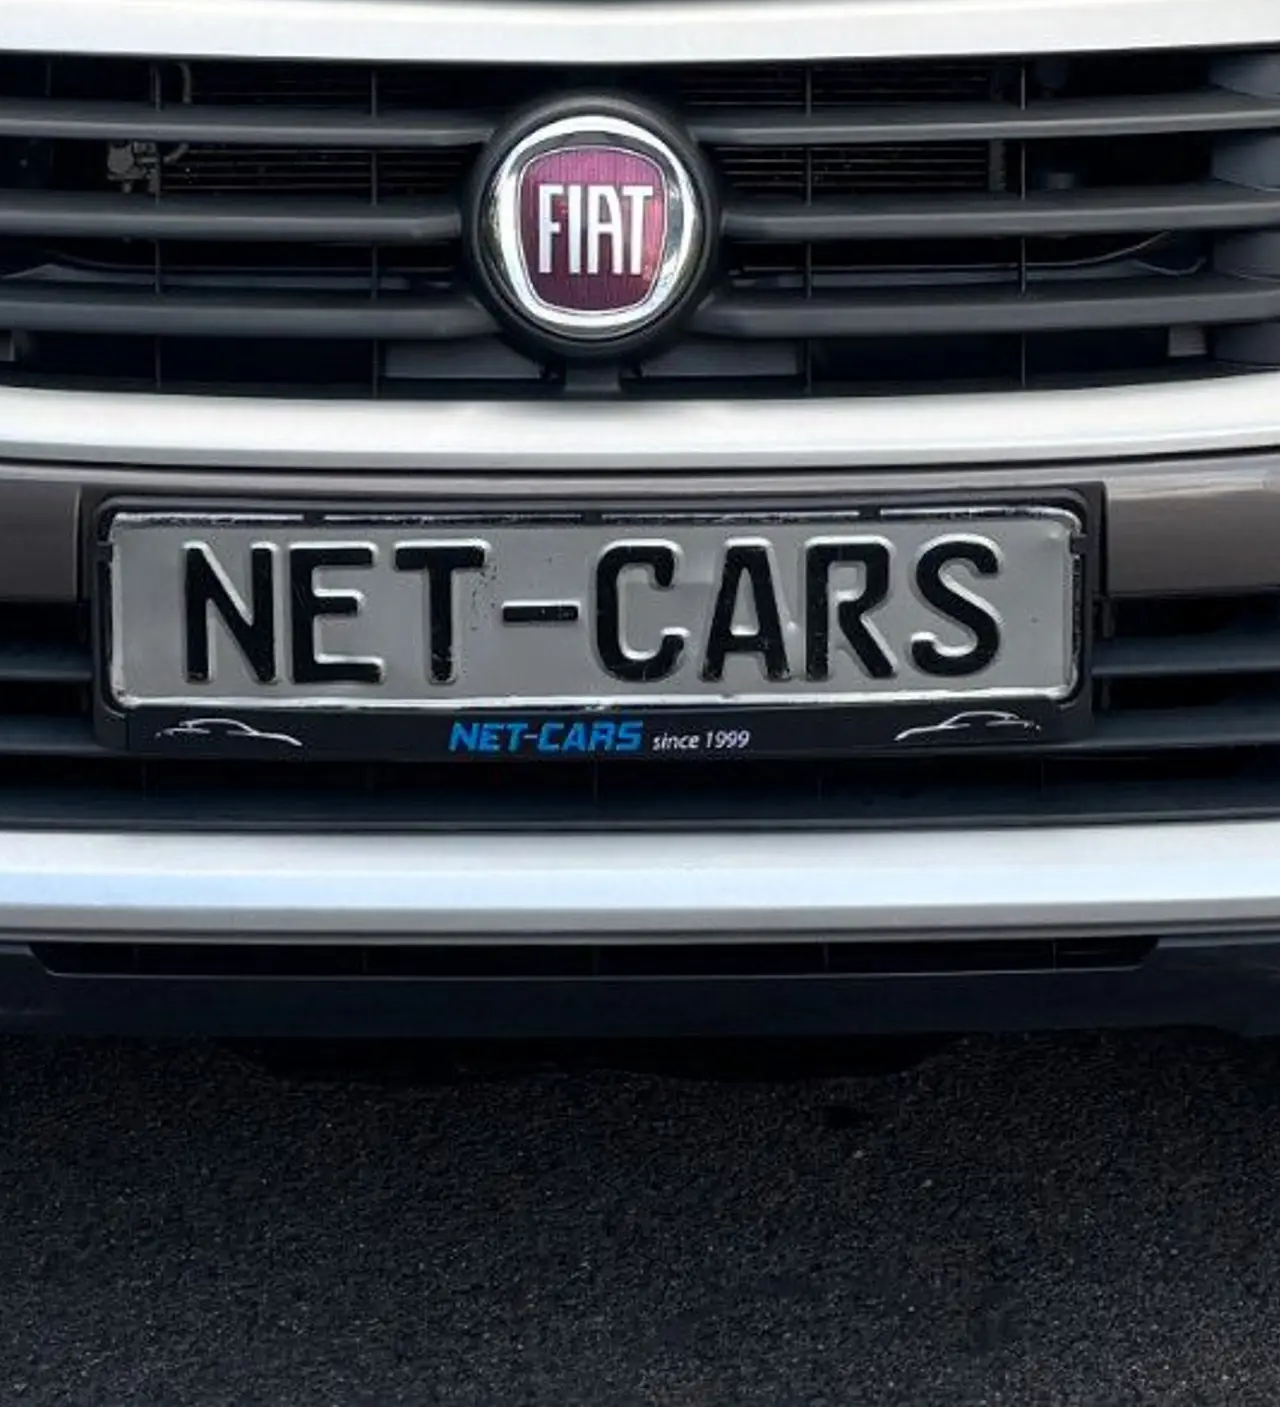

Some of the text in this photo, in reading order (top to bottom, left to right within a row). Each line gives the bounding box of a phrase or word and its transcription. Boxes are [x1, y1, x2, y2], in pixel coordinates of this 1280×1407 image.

[538, 184, 654, 275] FIAT
[183, 536, 1004, 685] NET-CARS
[448, 720, 751, 752] NET-CARS since 1999
